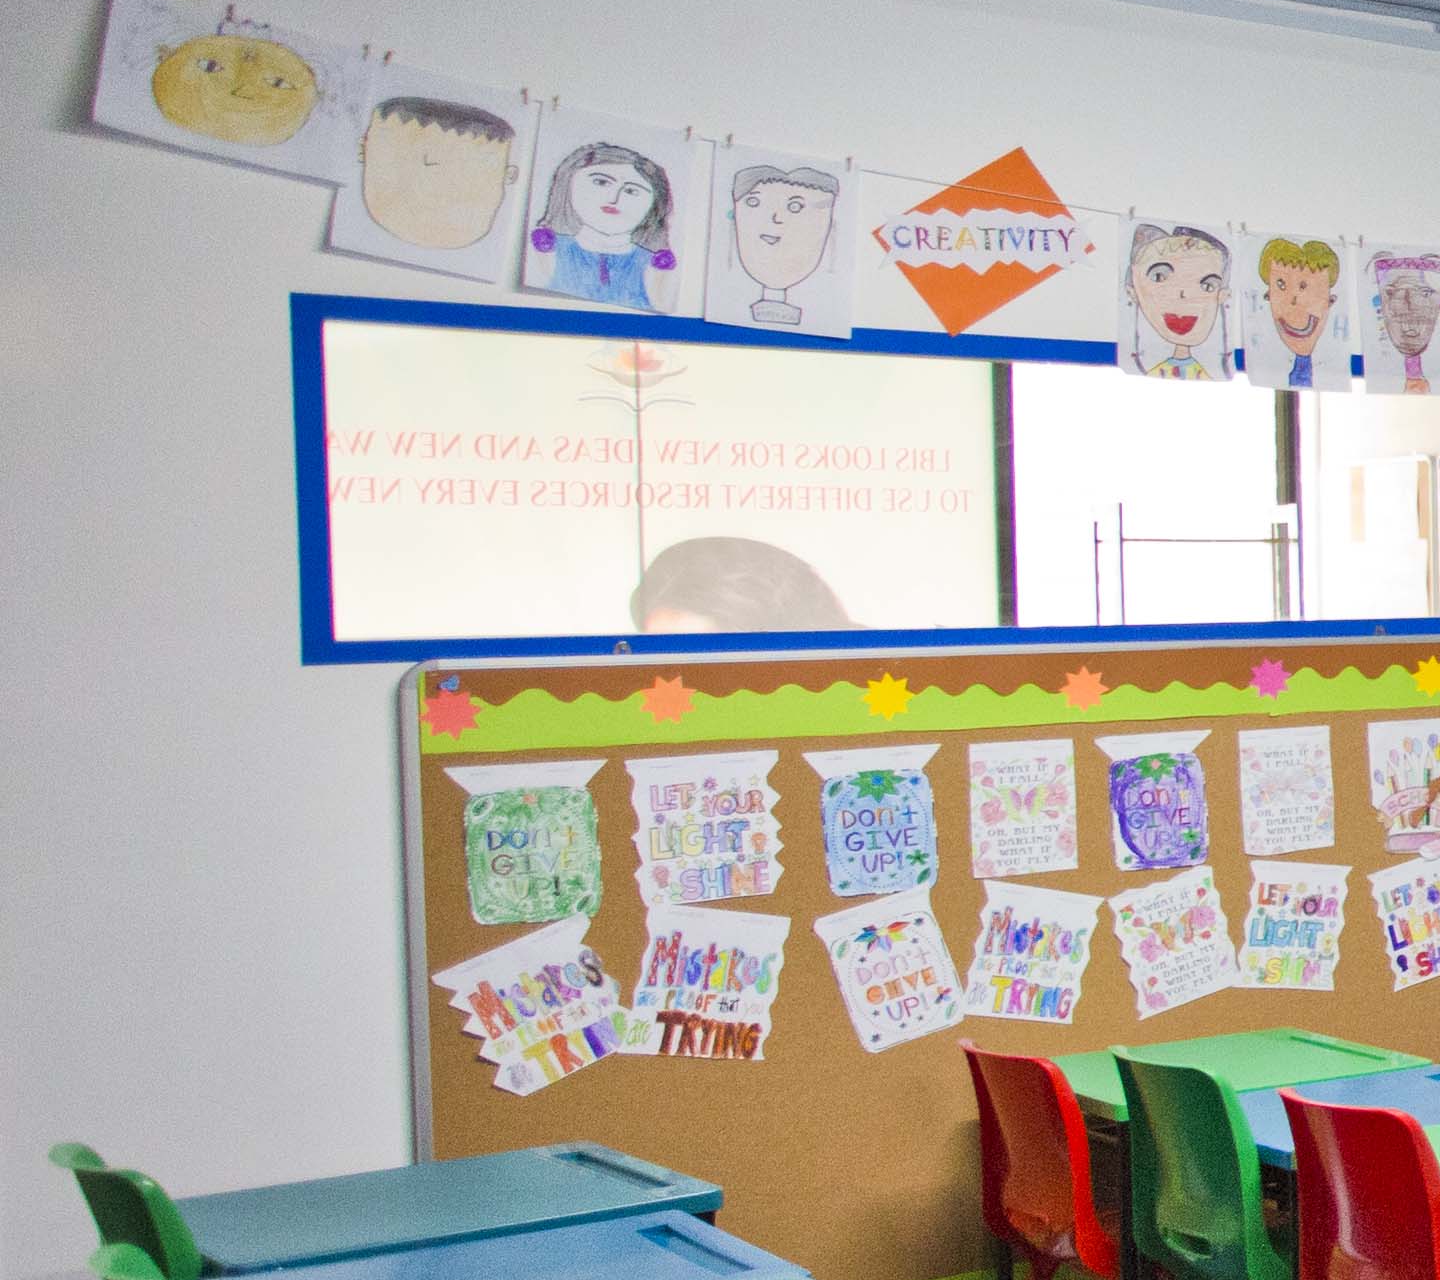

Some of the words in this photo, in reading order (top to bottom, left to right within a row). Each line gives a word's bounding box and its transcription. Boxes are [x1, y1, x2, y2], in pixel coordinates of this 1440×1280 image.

[892, 225, 1076, 252] CREATIVITY
[650, 782, 696, 812] LET
[702, 789, 765, 817] YOUR
[650, 818, 749, 861] LIGHT
[845, 827, 918, 852] GIVE
[491, 851, 576, 875] GIVE
[862, 851, 903, 873] UP!
[680, 861, 771, 901] SHINE
[1250, 918, 1324, 949] LIGHT
[866, 967, 936, 1005] GIVE
[991, 976, 1073, 1019] TRYING
[656, 1009, 762, 1059] TRYING
